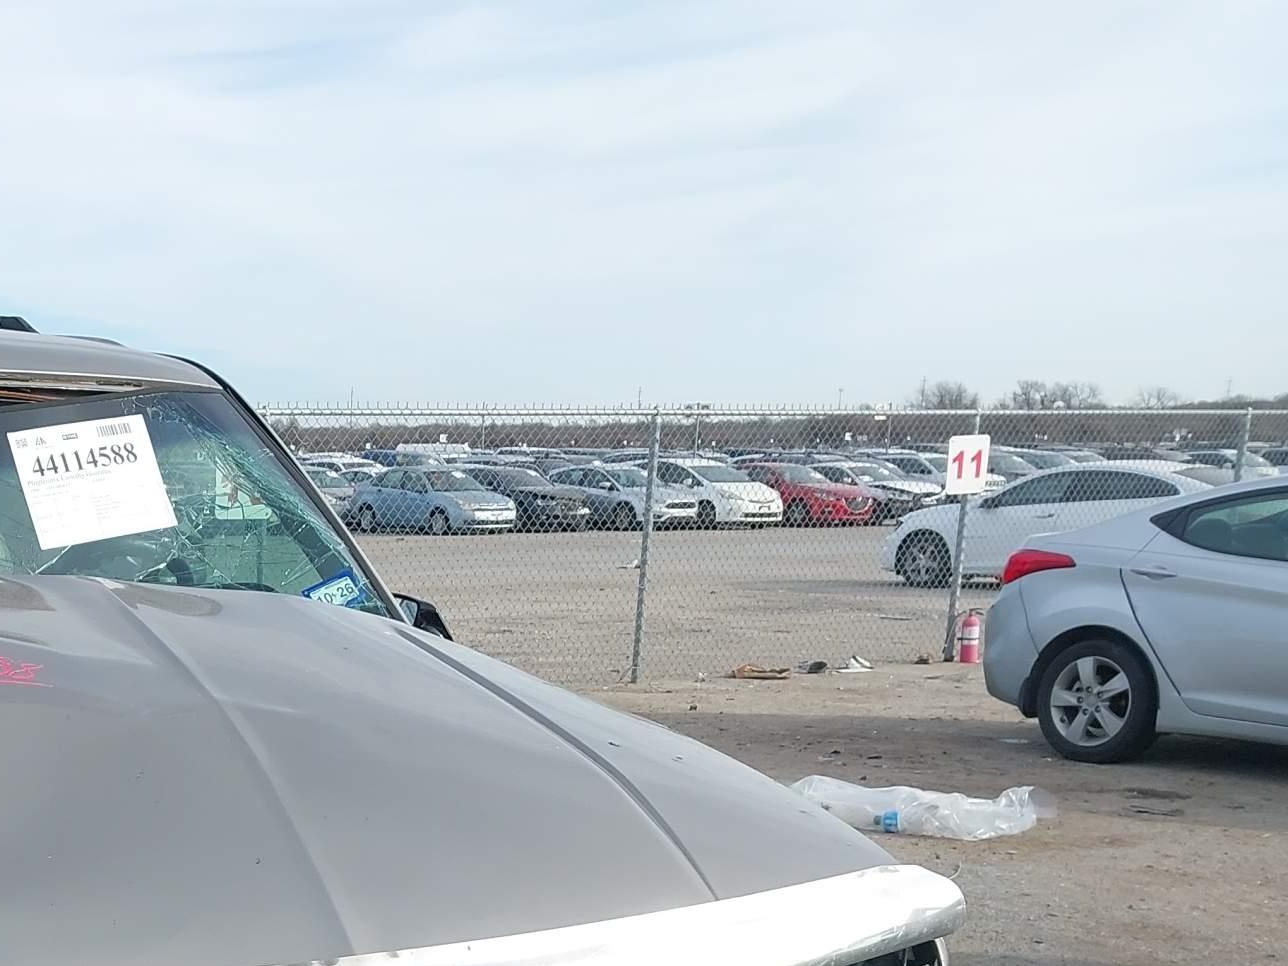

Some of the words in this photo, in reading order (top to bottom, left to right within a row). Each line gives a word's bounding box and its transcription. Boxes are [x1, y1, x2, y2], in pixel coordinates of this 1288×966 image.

[32, 442, 138, 477] 44114588
[952, 449, 982, 479] 11
[336, 583, 354, 598] 26
